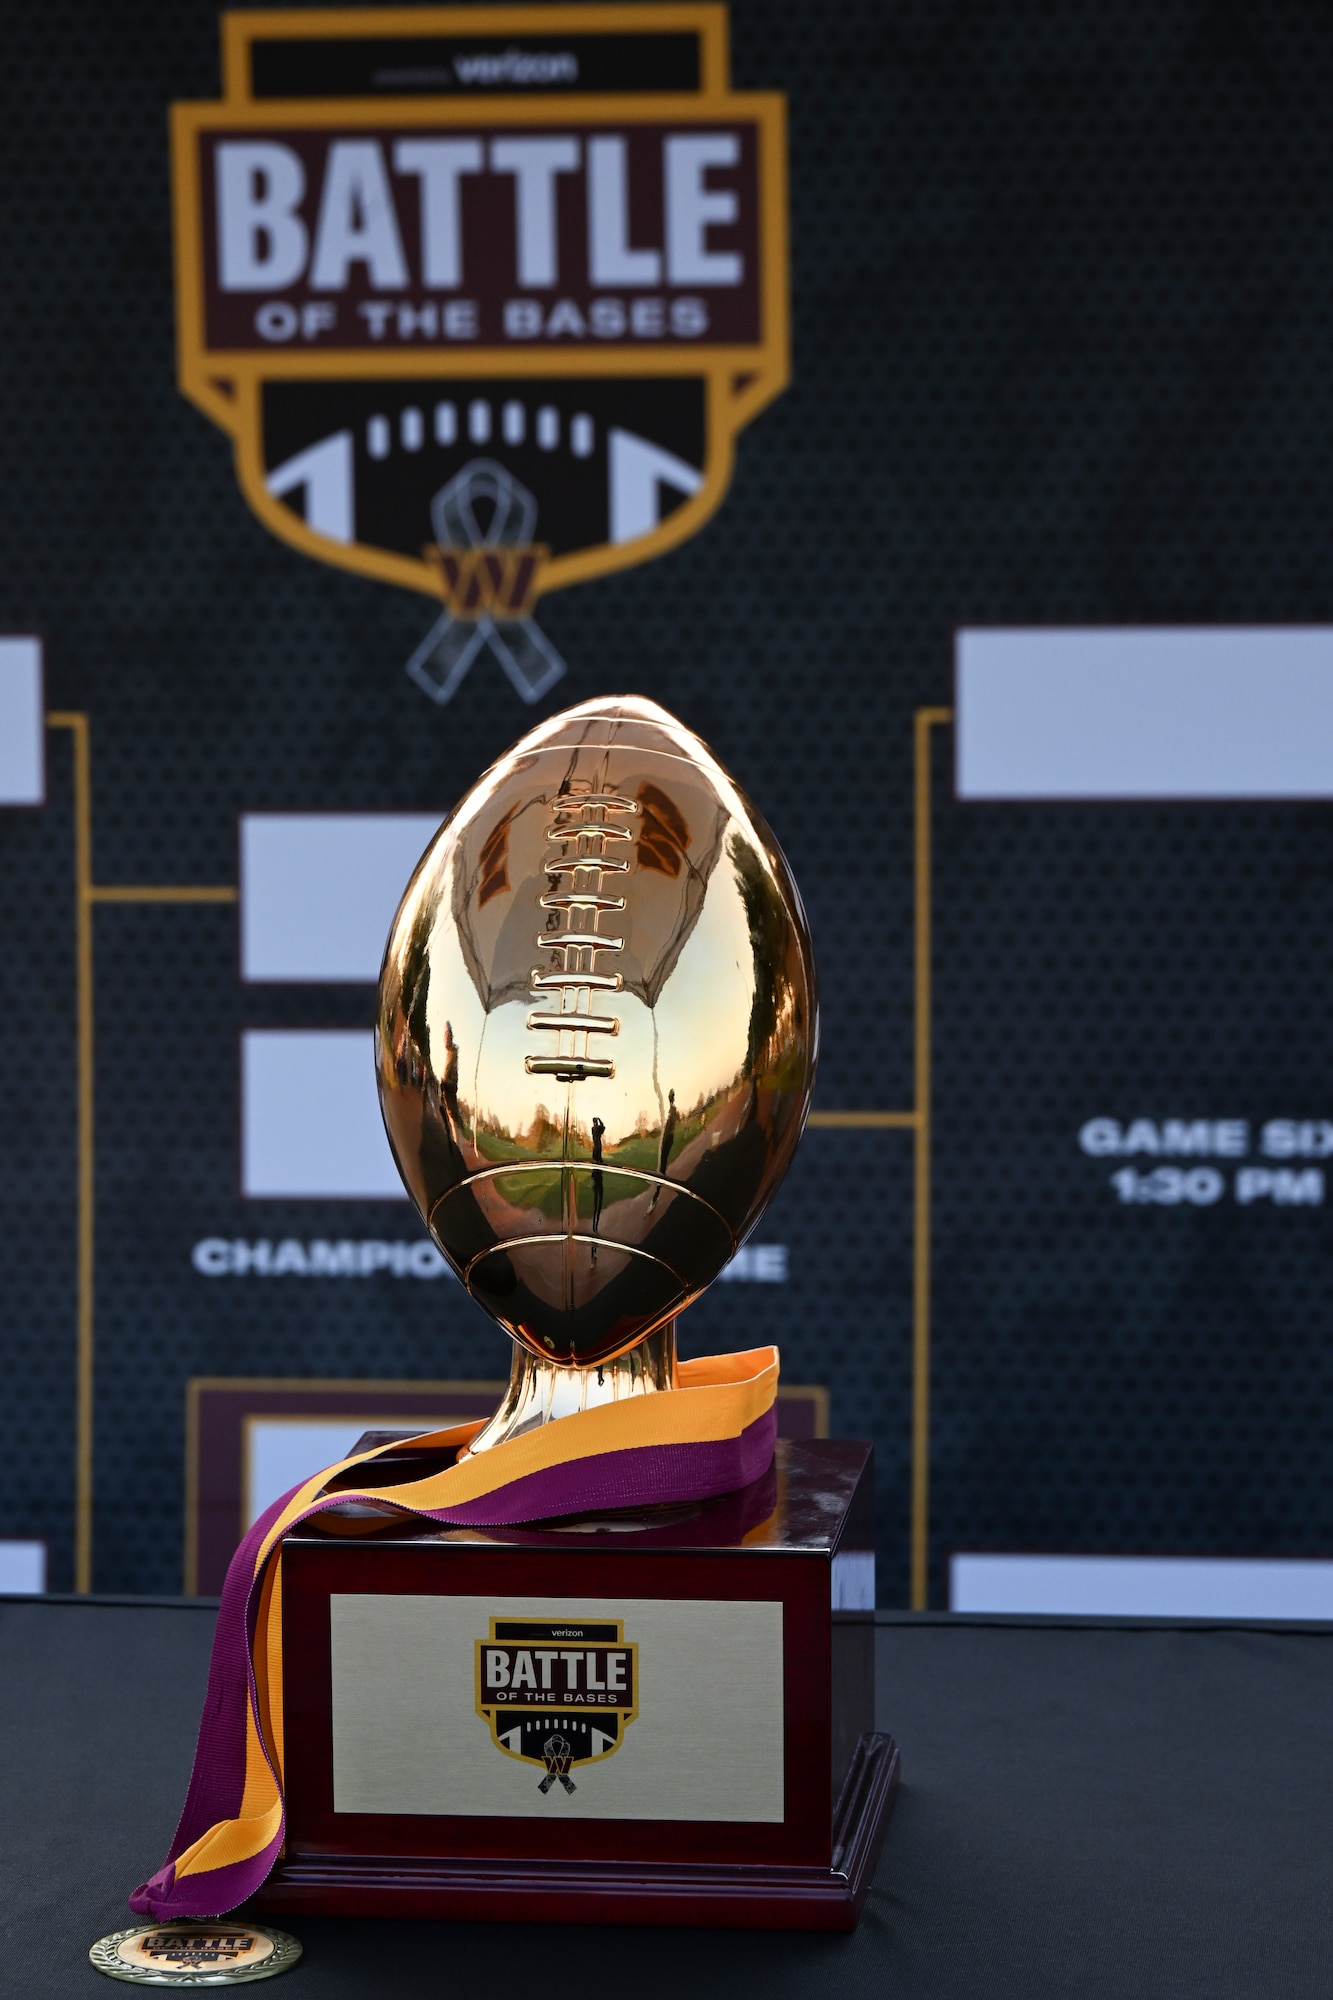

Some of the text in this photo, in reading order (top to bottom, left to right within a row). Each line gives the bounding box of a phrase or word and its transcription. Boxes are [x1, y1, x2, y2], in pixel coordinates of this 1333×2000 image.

[454, 49, 578, 83] verizon
[214, 134, 743, 291] BATTLE
[255, 297, 710, 341] OF THE BASES
[1079, 1117, 1249, 1157] GAME
[1111, 1166, 1325, 1206] 1:30 PM
[192, 1237, 455, 1279] CHAMPIO
[551, 1629, 584, 1637] verizon
[486, 1650, 627, 1691] BATTLE
[496, 1692, 618, 1703] OF THE BASES
[147, 1938, 249, 1947] BATTLE
